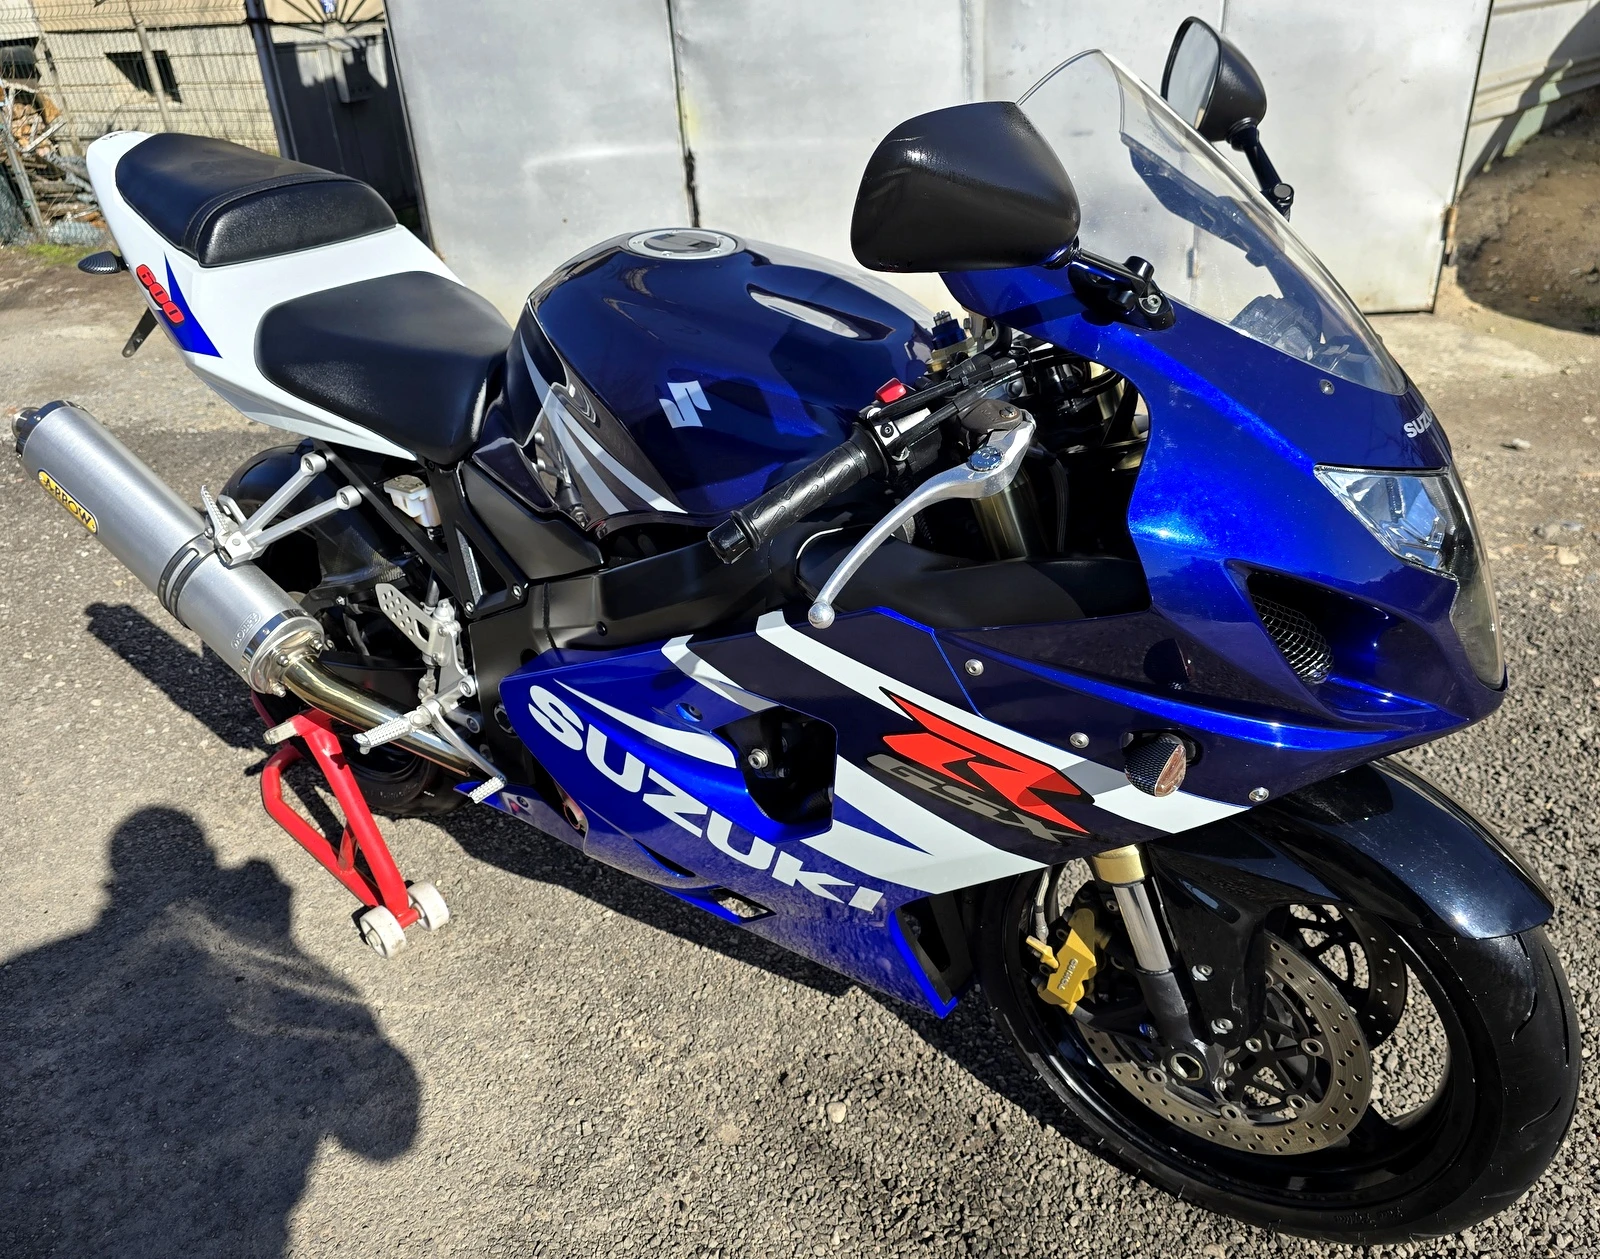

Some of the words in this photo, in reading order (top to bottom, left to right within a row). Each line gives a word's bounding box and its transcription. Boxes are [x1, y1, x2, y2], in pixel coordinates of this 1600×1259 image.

[136, 264, 185, 324] 600
[1403, 405, 1433, 438] SUZU
[44, 477, 92, 525] ARROW
[528, 685, 884, 914] SUZUKI
